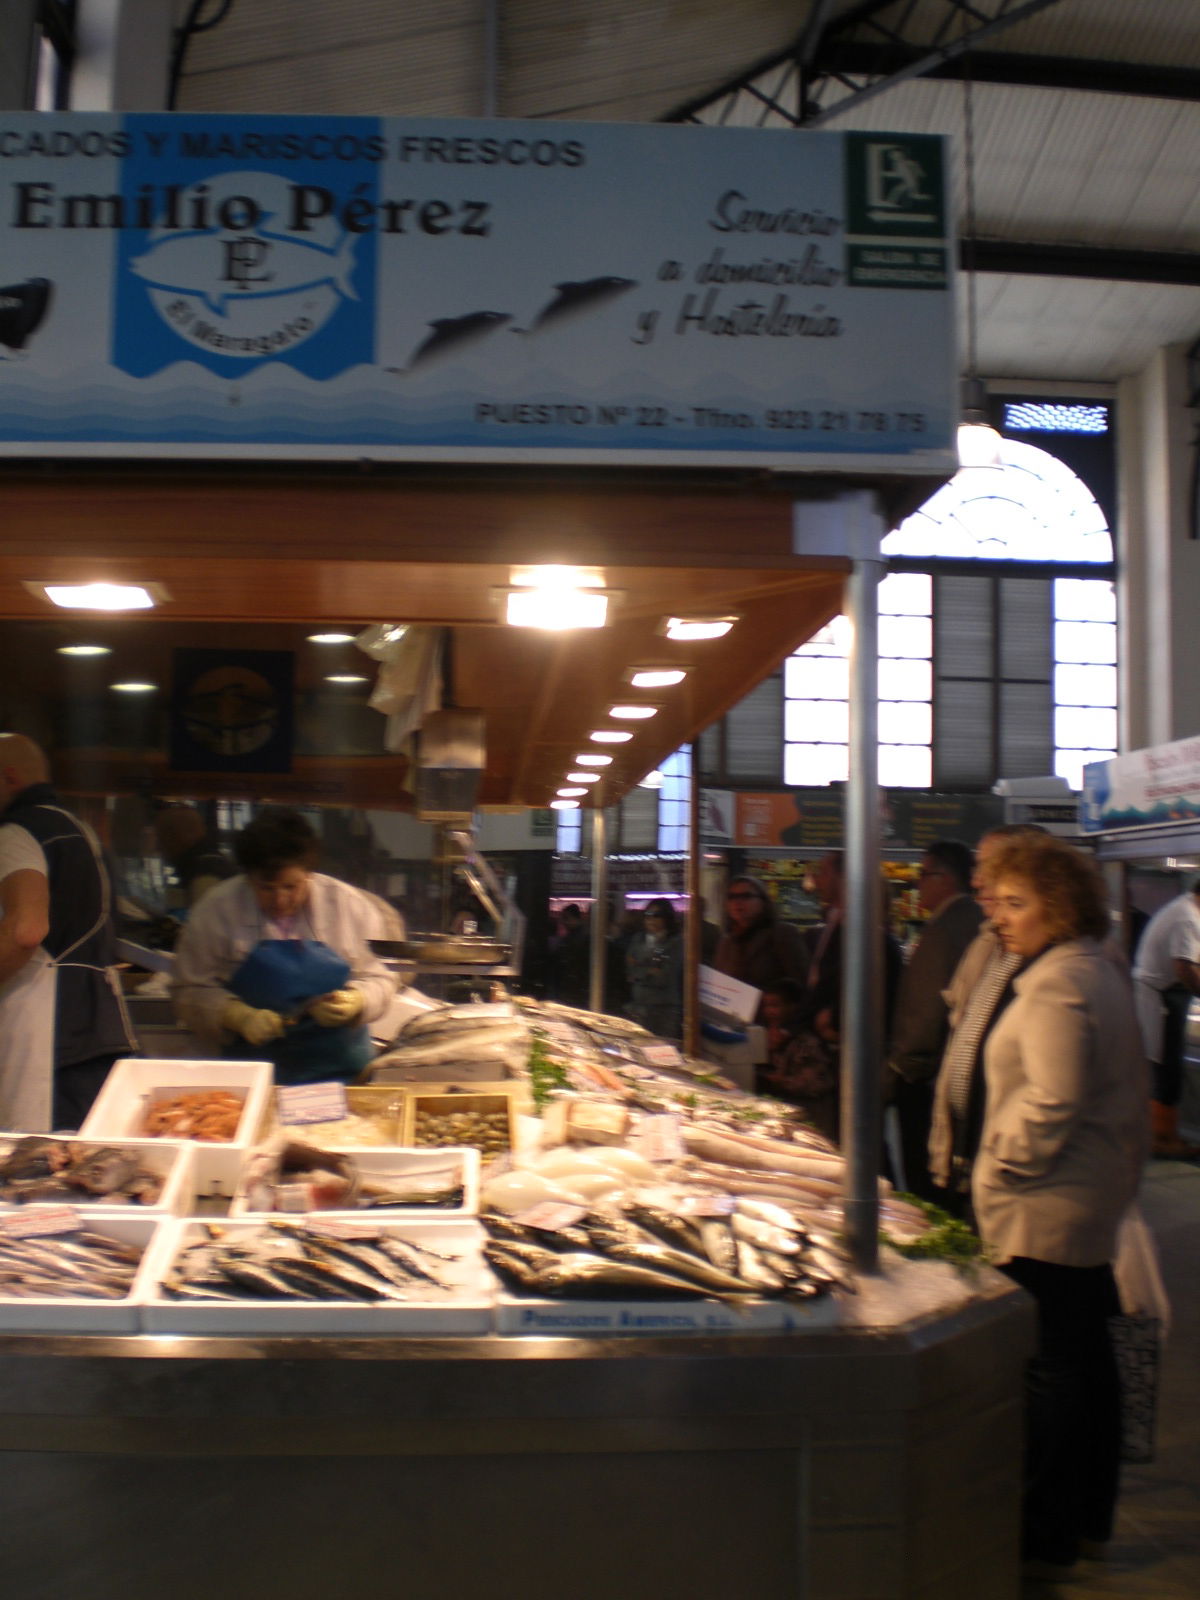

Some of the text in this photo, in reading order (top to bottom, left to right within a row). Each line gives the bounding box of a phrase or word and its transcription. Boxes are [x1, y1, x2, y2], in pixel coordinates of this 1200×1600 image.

[0, 130, 586, 168] CADOS Y MARISCOS FRESCOS
[11, 181, 493, 237] Emilio Pérez
[656, 259, 684, 281] a
[694, 242, 843, 287] domicilio
[629, 310, 660, 346] y
[475, 403, 591, 425] PUESTO
[635, 406, 669, 427] 22
